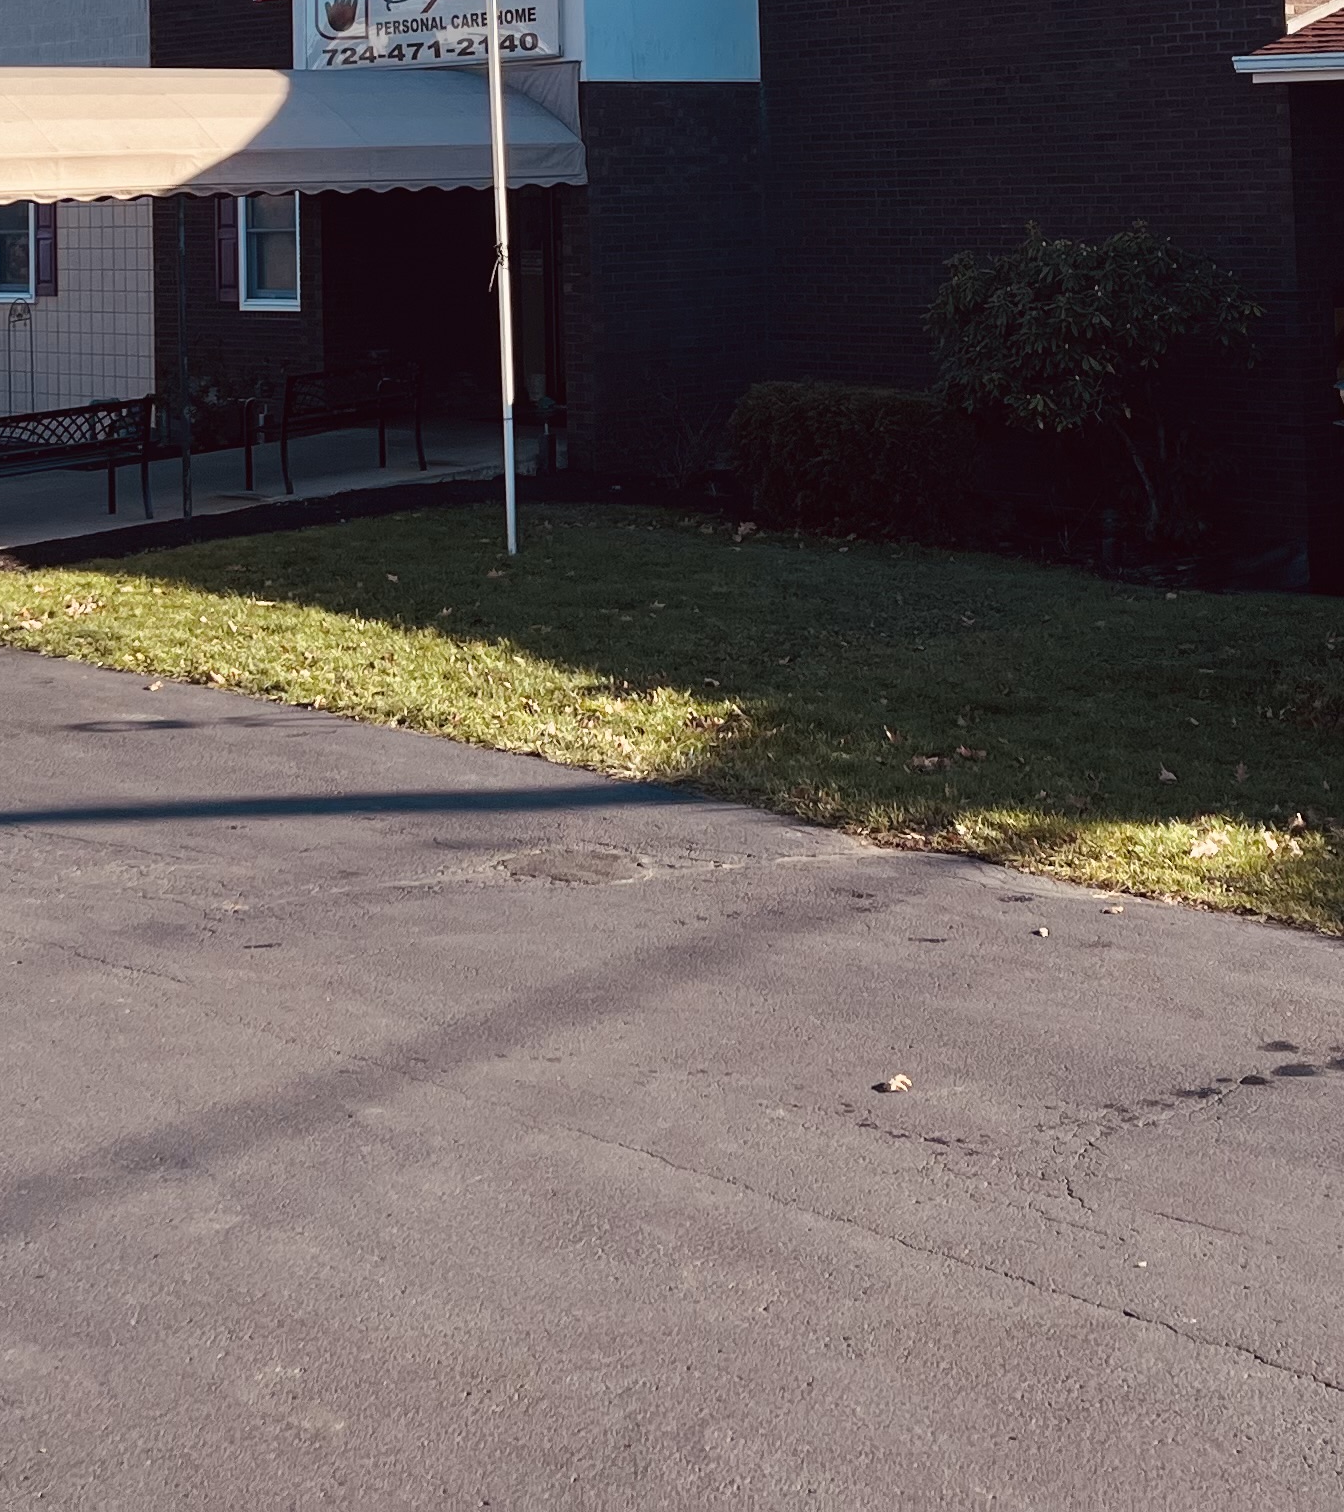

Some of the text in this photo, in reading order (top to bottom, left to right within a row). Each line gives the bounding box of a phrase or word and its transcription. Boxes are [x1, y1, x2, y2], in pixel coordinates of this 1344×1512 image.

[376, 16, 447, 36] PERSONAL
[451, 13, 487, 29] CARE
[322, 33, 539, 66] 724-471-2140
